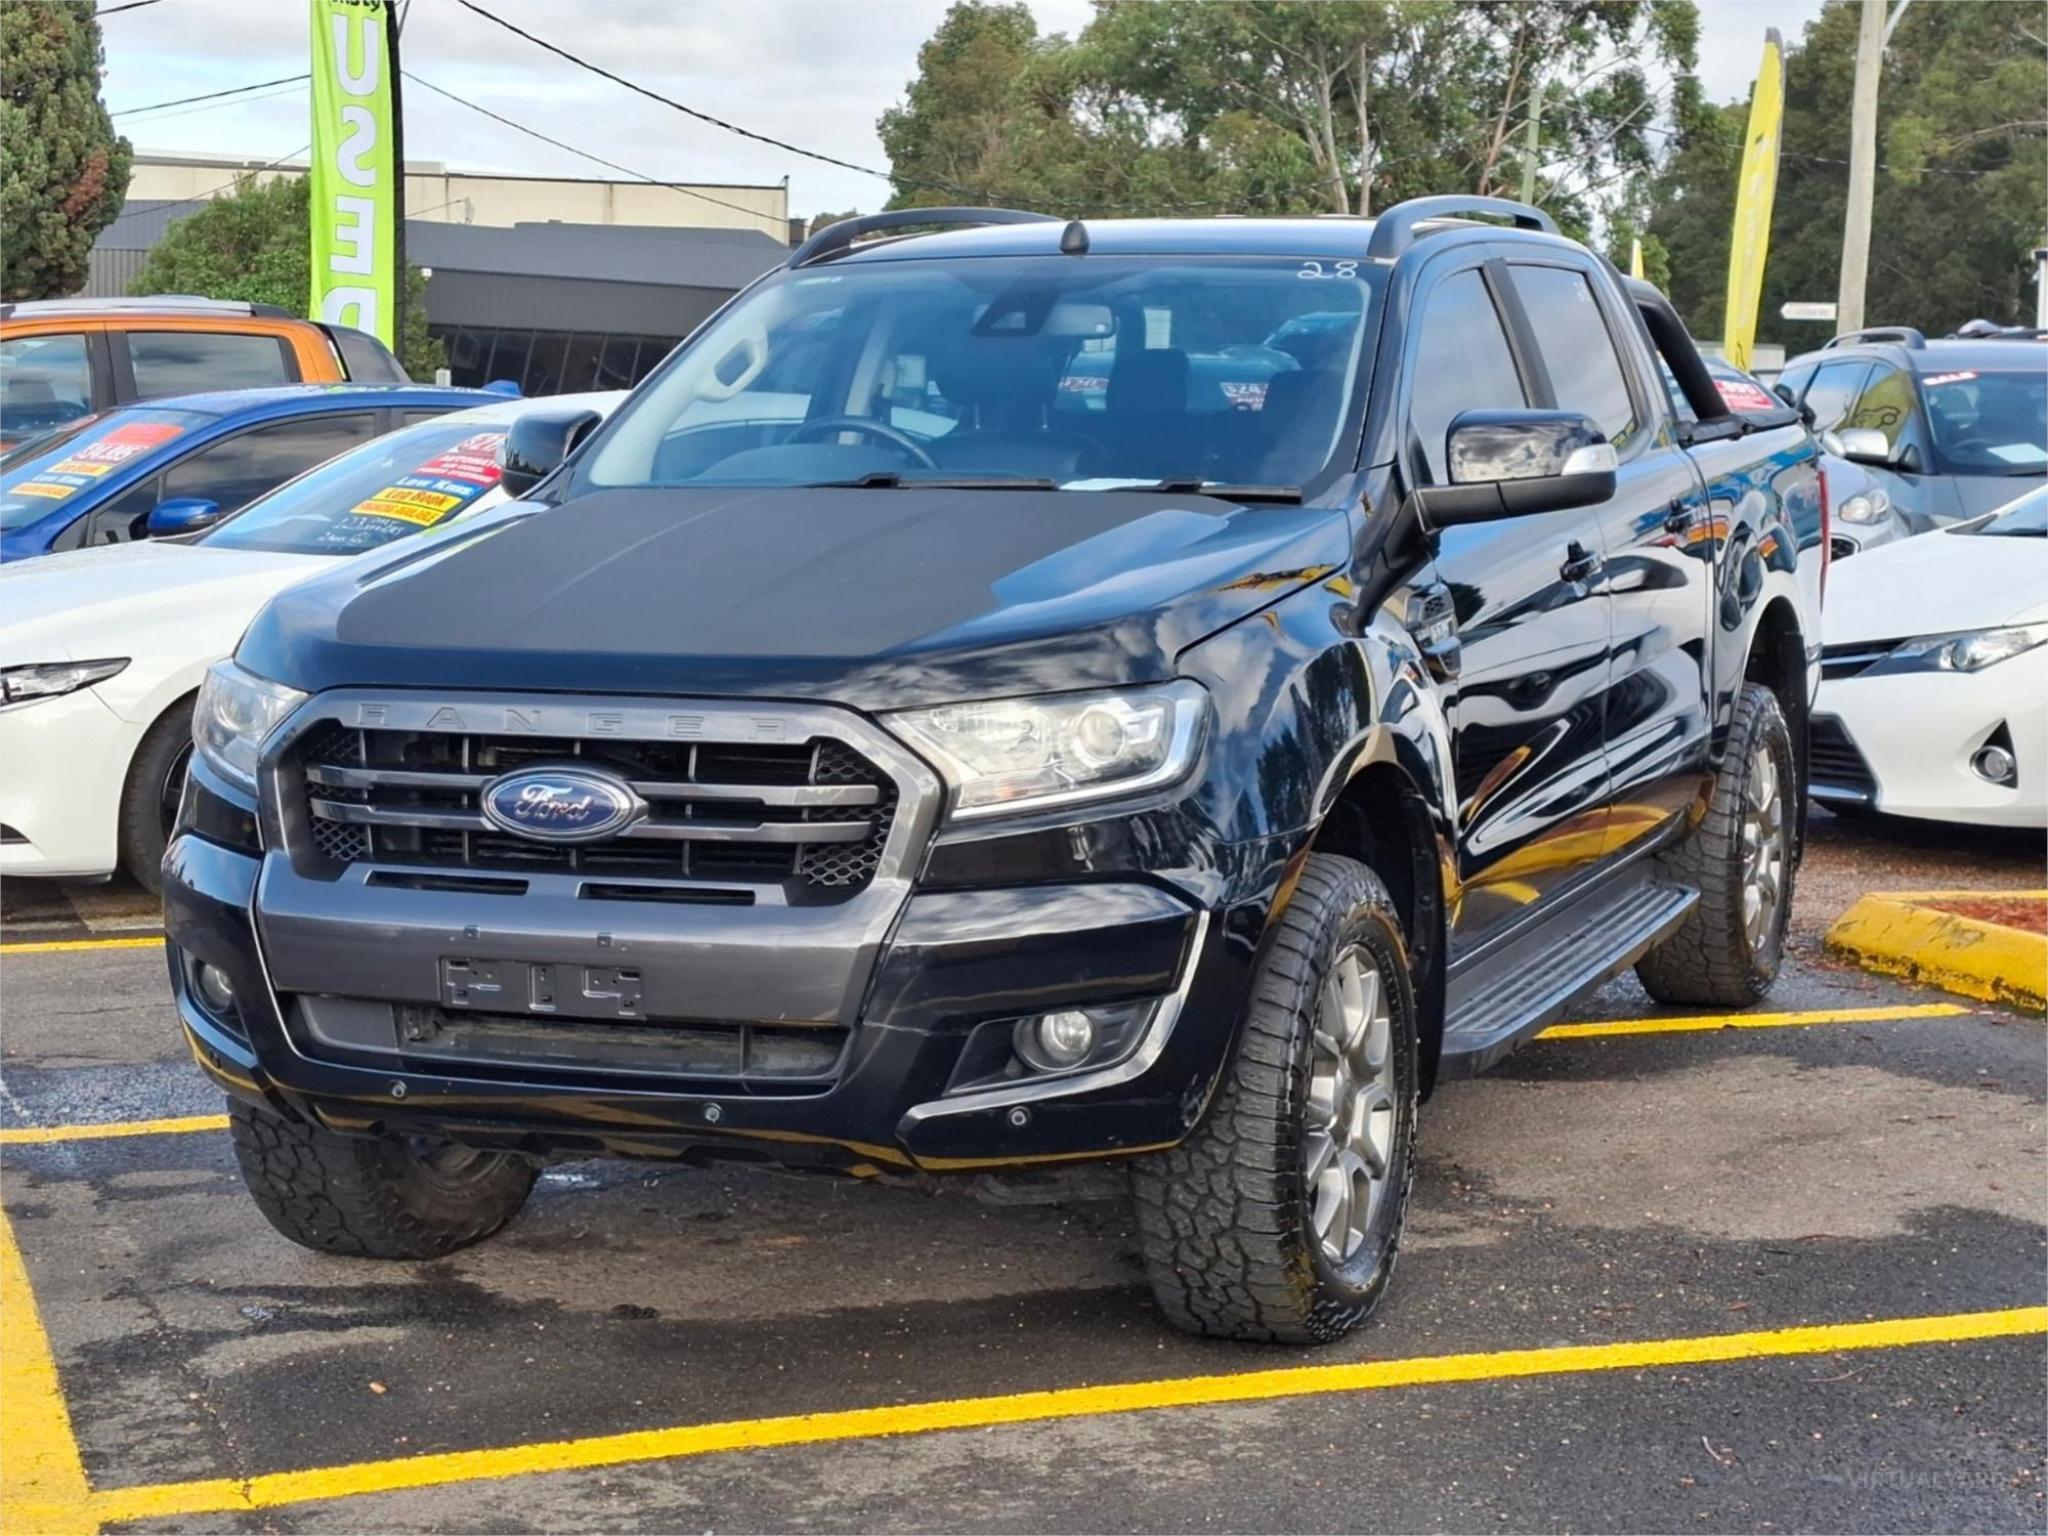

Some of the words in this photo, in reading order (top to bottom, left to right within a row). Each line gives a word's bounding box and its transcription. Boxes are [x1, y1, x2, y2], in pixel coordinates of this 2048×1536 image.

[1297, 261, 1359, 280] 28
[395, 475, 433, 488] Low
[410, 490, 450, 508] Book
[357, 703, 786, 741] RANGER
[514, 783, 594, 821] Ford
